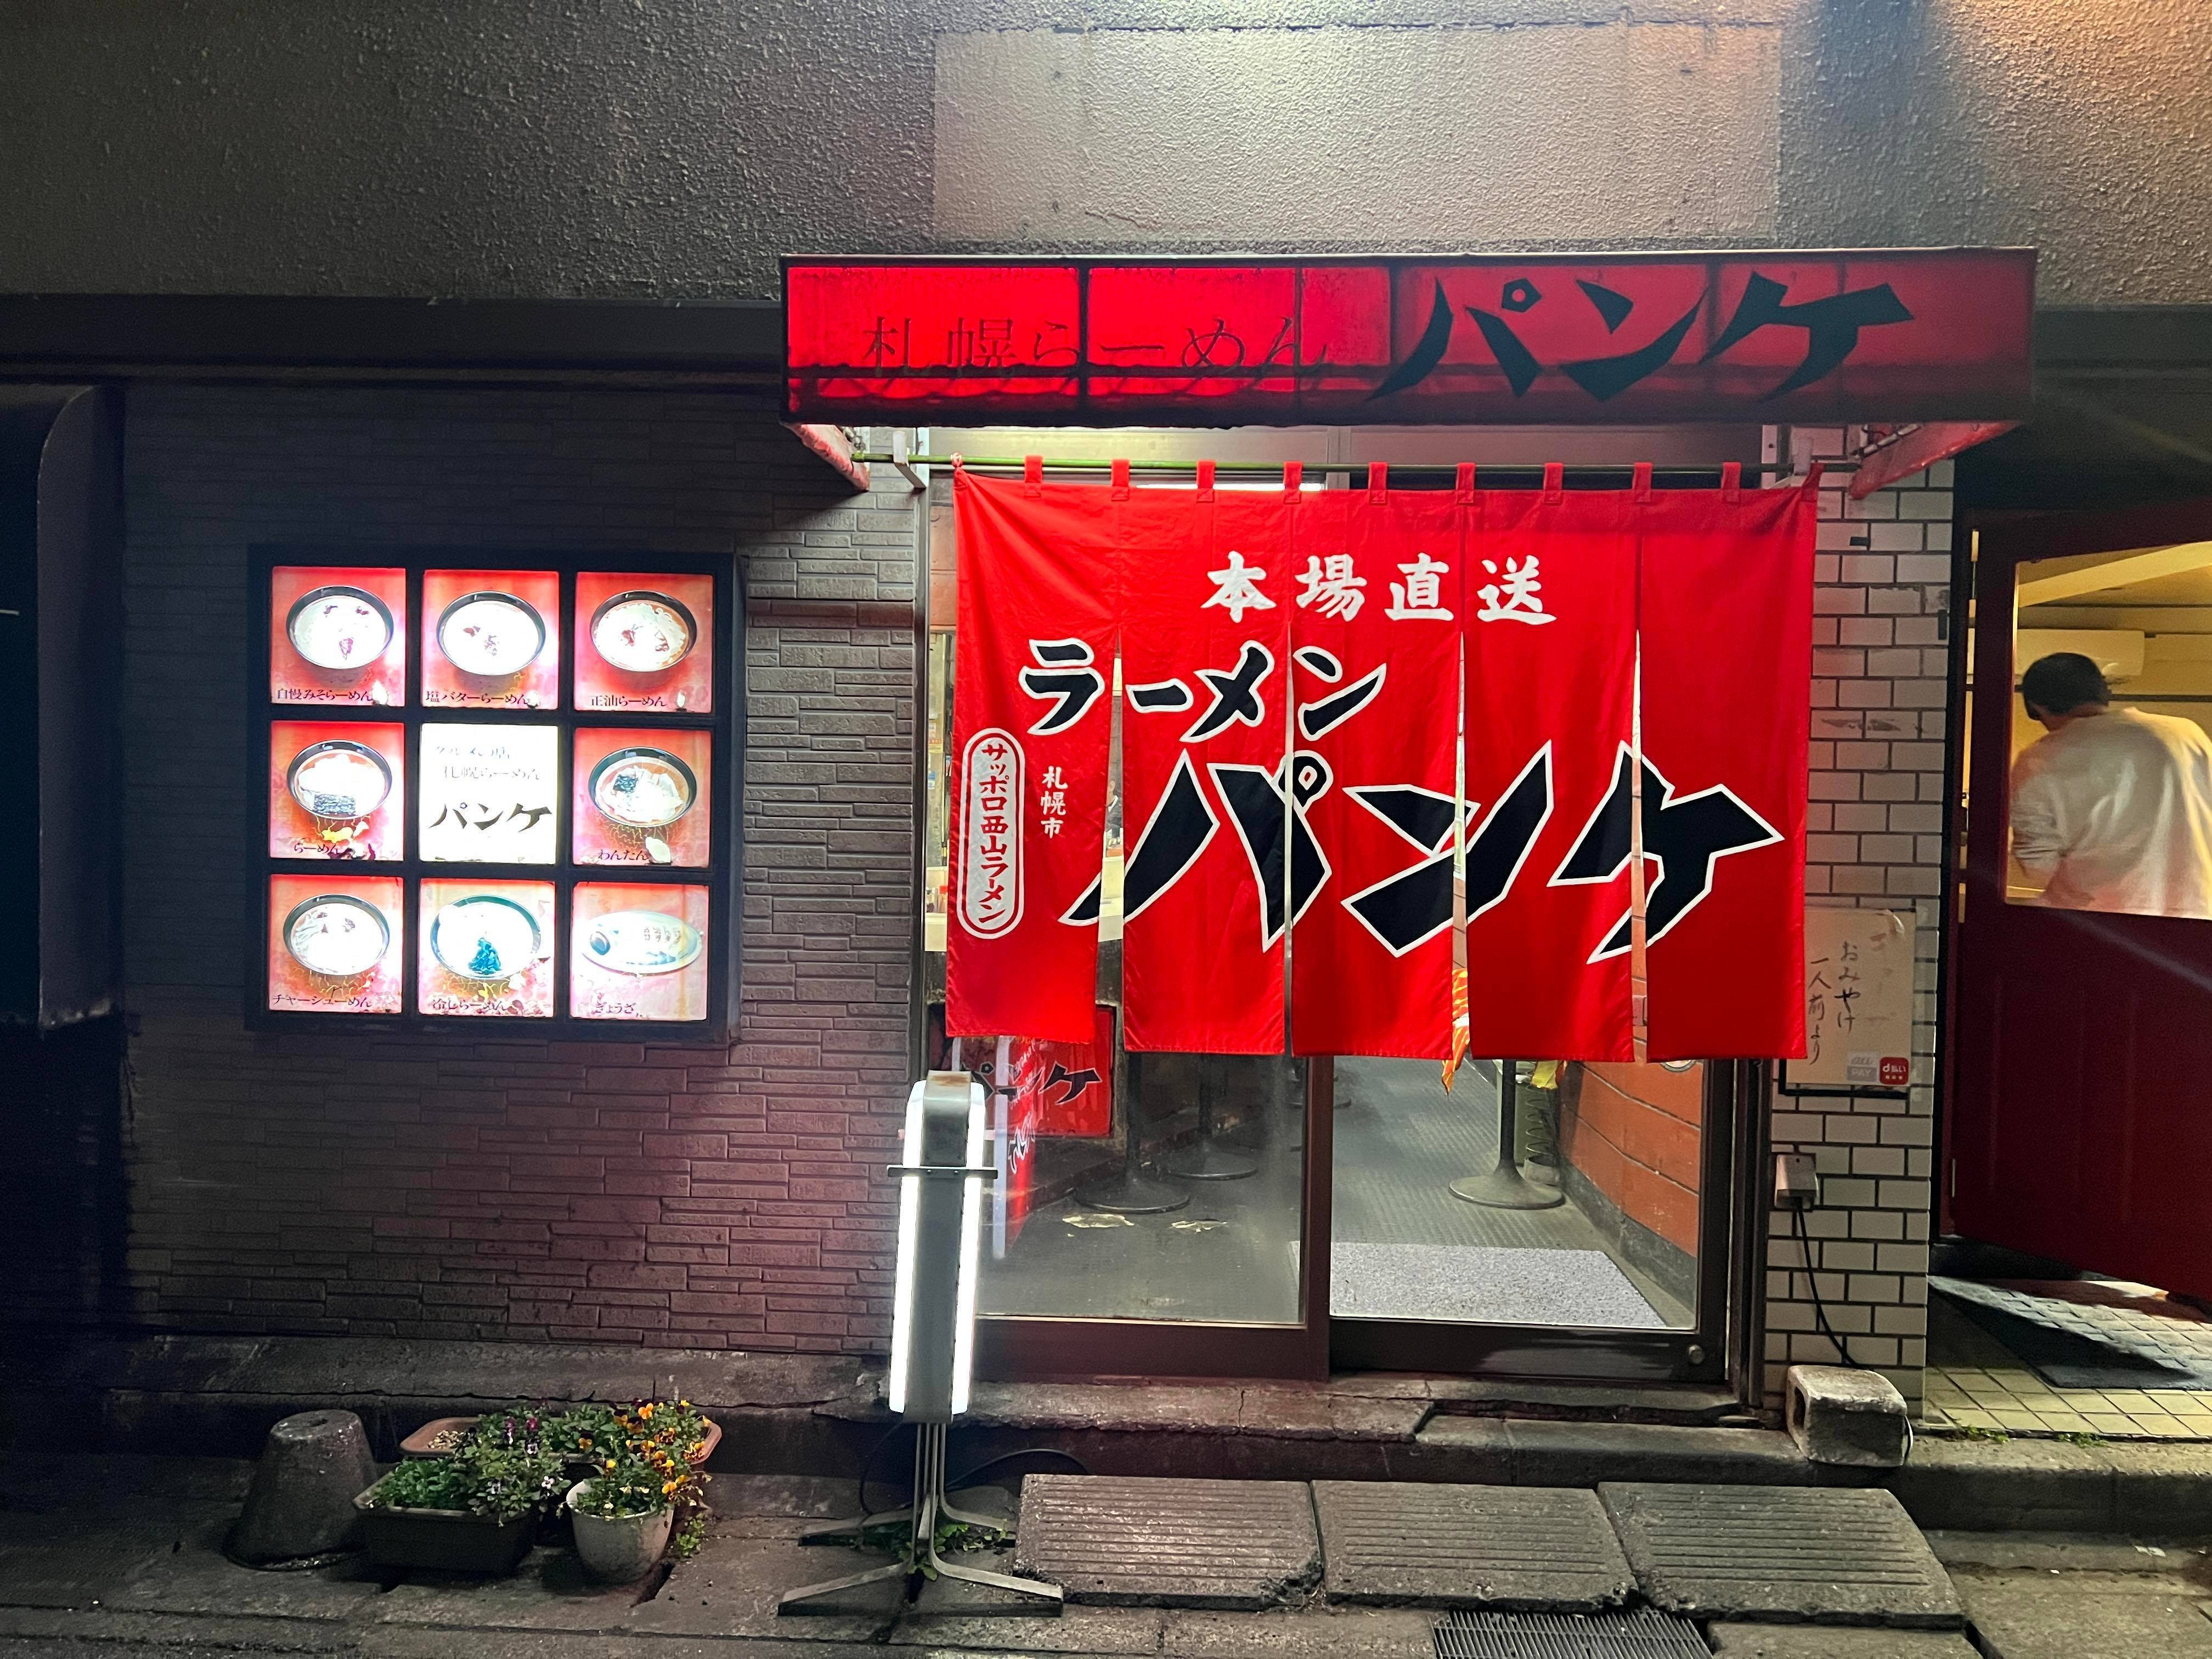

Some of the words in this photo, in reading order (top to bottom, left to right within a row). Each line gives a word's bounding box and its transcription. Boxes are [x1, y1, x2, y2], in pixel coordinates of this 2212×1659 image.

[1365, 270, 1915, 403] パンケ
[1200, 550, 1558, 625] 本場直送
[426, 690, 530, 705] 塩バターらーめん
[590, 695, 667, 707] 正油らーめん
[1018, 637, 1388, 743] ラーメン
[428, 802, 552, 833] パンケ
[978, 743, 1010, 924] サッポロ西山ラーメン
[1040, 766, 1068, 839] 札幌市
[597, 850, 648, 861] わんたん
[1058, 741, 1786, 964] パンケ
